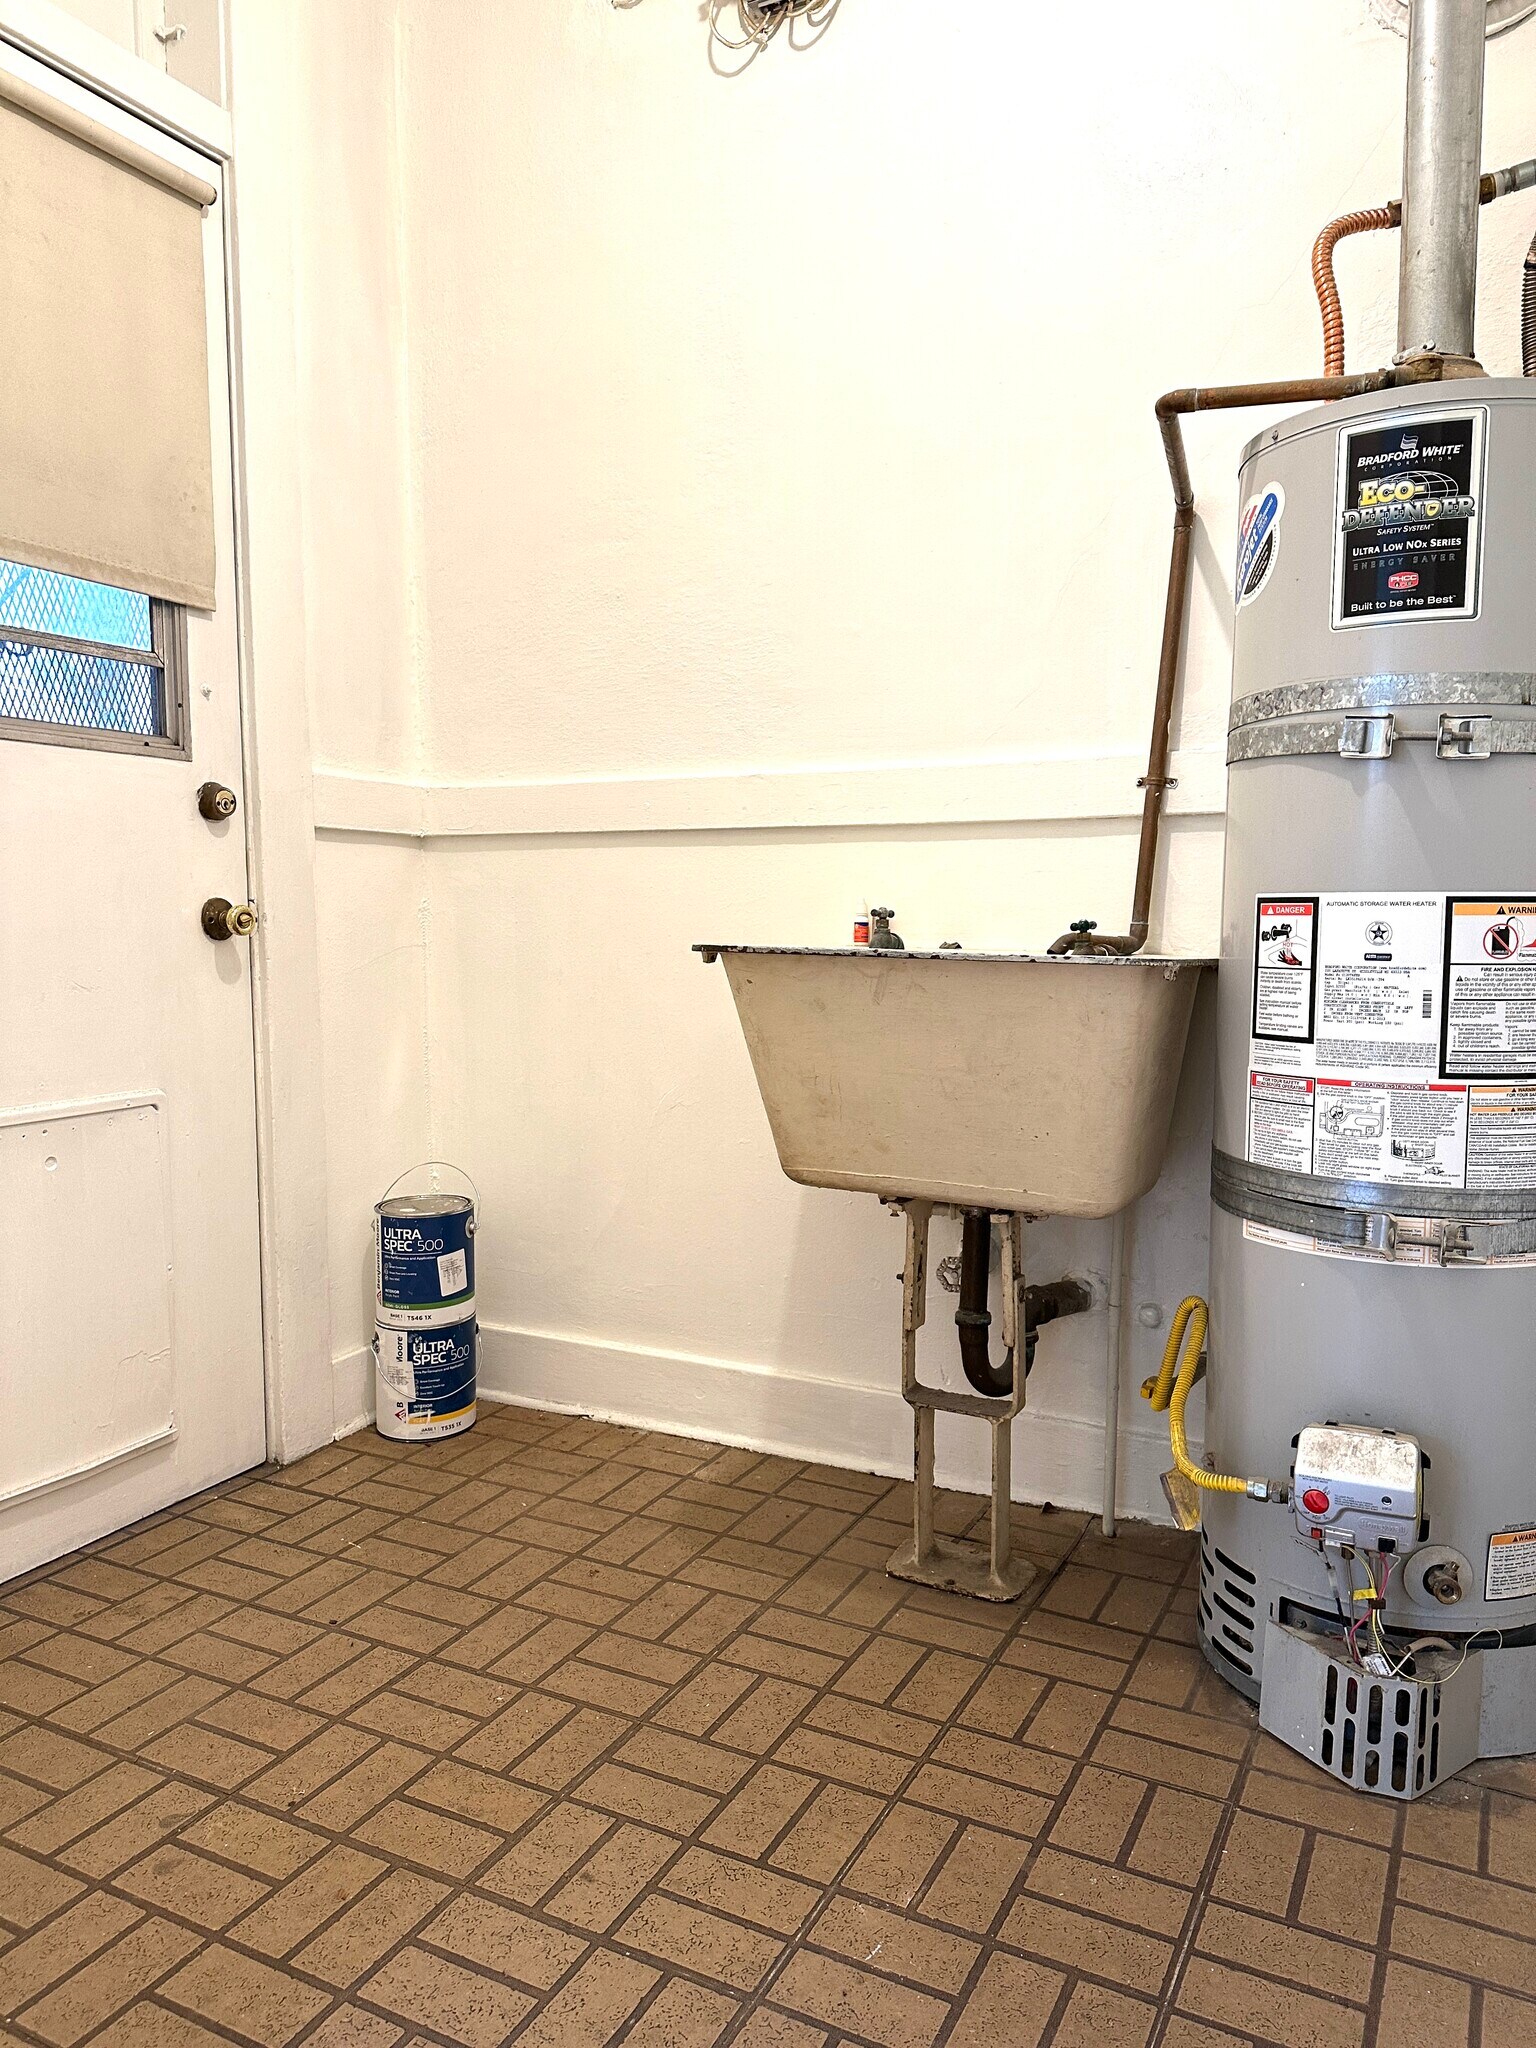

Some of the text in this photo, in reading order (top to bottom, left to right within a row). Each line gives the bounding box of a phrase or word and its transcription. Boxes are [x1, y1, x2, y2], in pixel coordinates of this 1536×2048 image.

[1357, 445, 1461, 467] BRADFORD WHITE
[1364, 457, 1452, 472] CORPORATION
[1342, 496, 1474, 532] DEFENDER
[1377, 524, 1431, 536] SAFETY SYSTEM
[1353, 538, 1461, 556] ULTRA LOW NOx SERIES
[1353, 553, 1455, 571] ENERGY SAVER
[1391, 574, 1417, 582] PHCC
[1351, 596, 1453, 612] Built to be the Best
[384, 1227, 421, 1240] ULTRA
[384, 1239, 443, 1251] SPEC 500
[412, 1339, 454, 1354] ULTRA
[413, 1344, 470, 1366] SPEC 500
